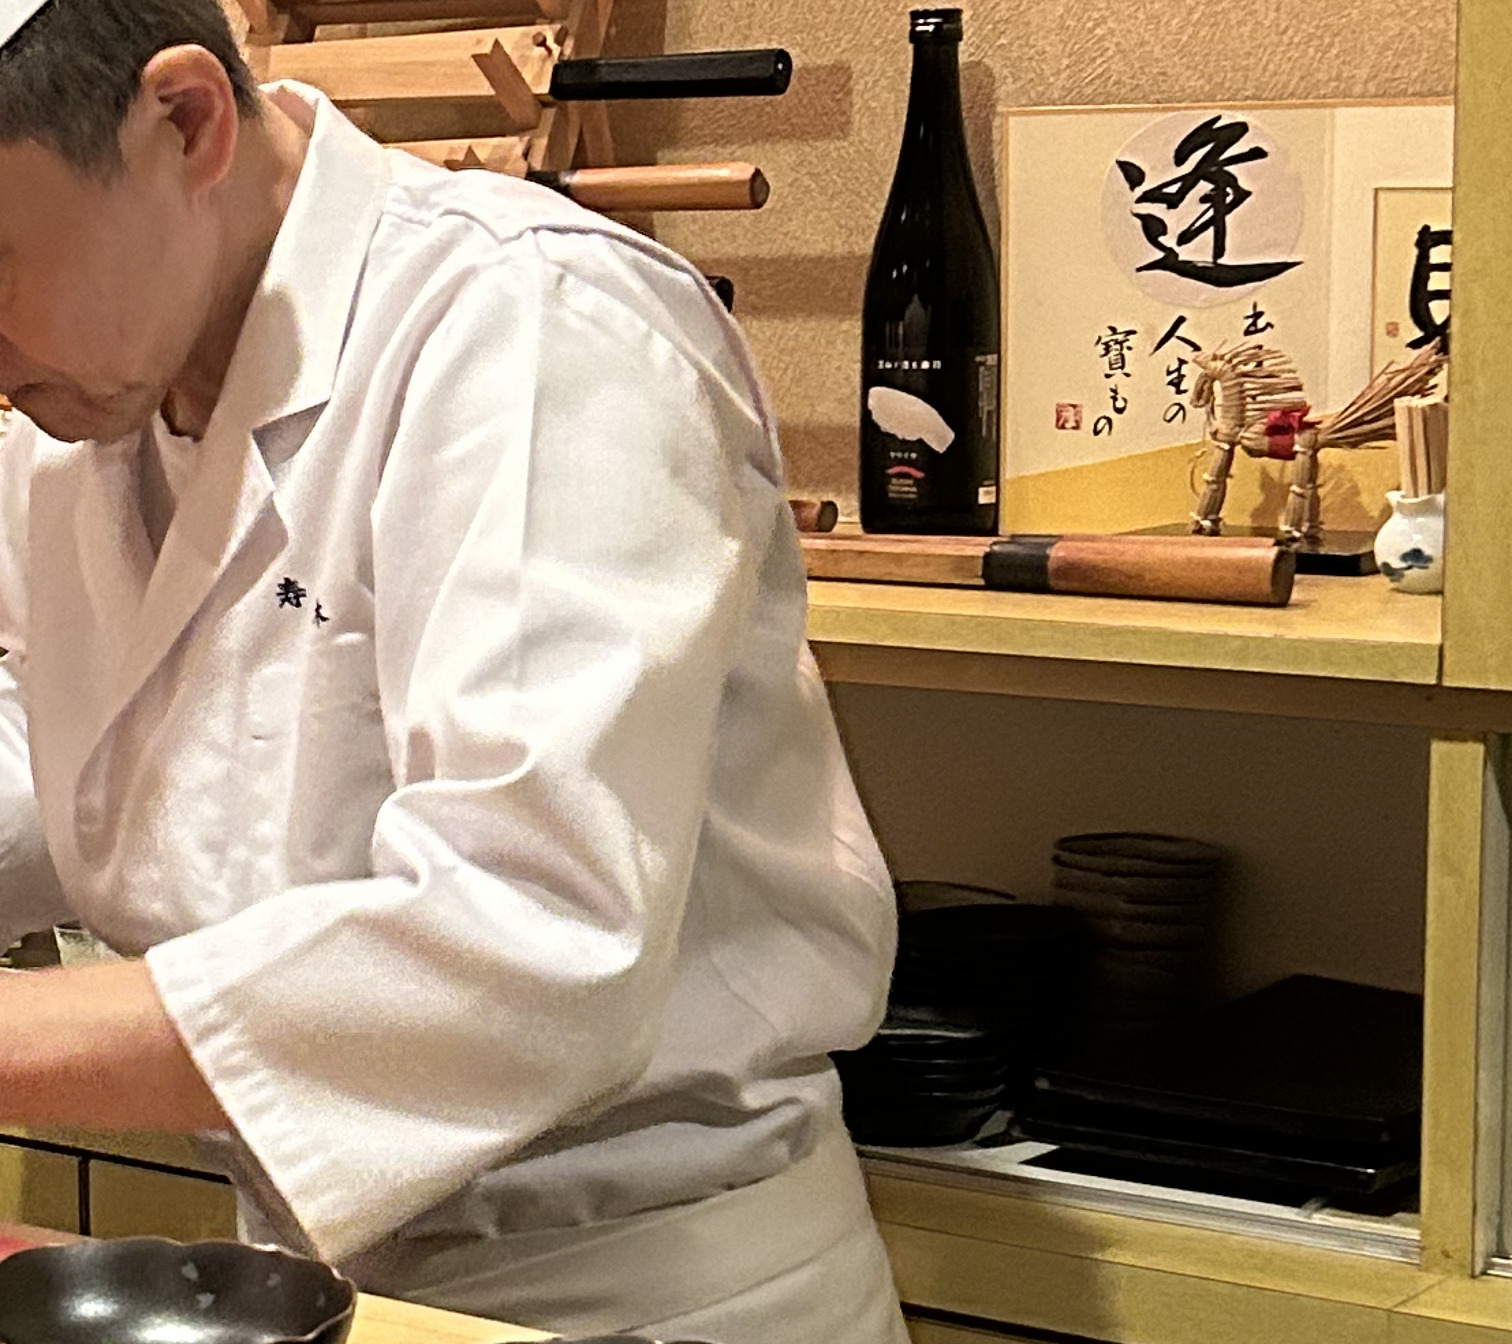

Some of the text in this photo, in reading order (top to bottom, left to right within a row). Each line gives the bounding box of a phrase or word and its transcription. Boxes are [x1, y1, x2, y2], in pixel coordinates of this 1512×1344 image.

[1115, 114, 1304, 288] 逢
[1149, 314, 1203, 424] 人生の
